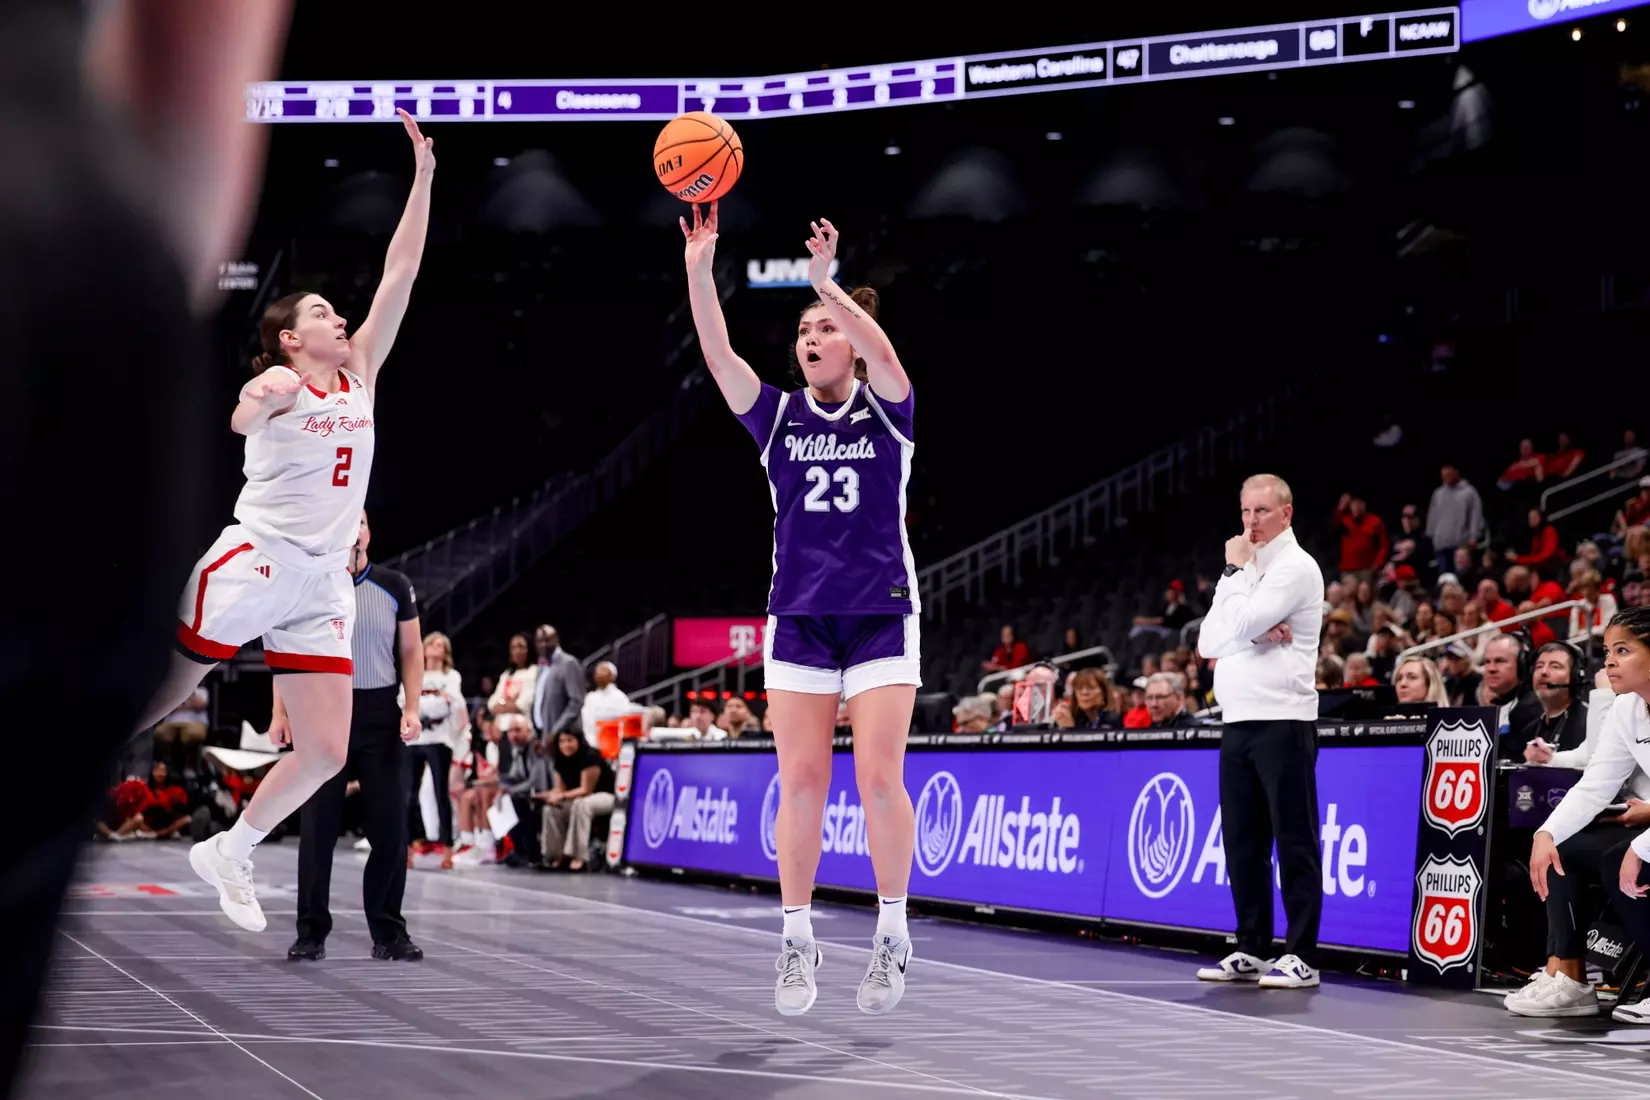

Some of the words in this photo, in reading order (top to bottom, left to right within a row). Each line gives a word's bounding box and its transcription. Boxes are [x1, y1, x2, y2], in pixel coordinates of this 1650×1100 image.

[302, 416, 335, 437] Lady
[332, 447, 353, 487] 2
[785, 433, 876, 461] Wildcats
[804, 465, 860, 513] 23
[1436, 739, 1481, 757] PHILLIPS
[1435, 769, 1476, 810] 66
[669, 786, 738, 844] Allstate
[957, 794, 1081, 874] Allstate
[1426, 872, 1471, 893] PHILLIPS
[1424, 903, 1465, 946] 66
[1590, 937, 1623, 958] Allstate
